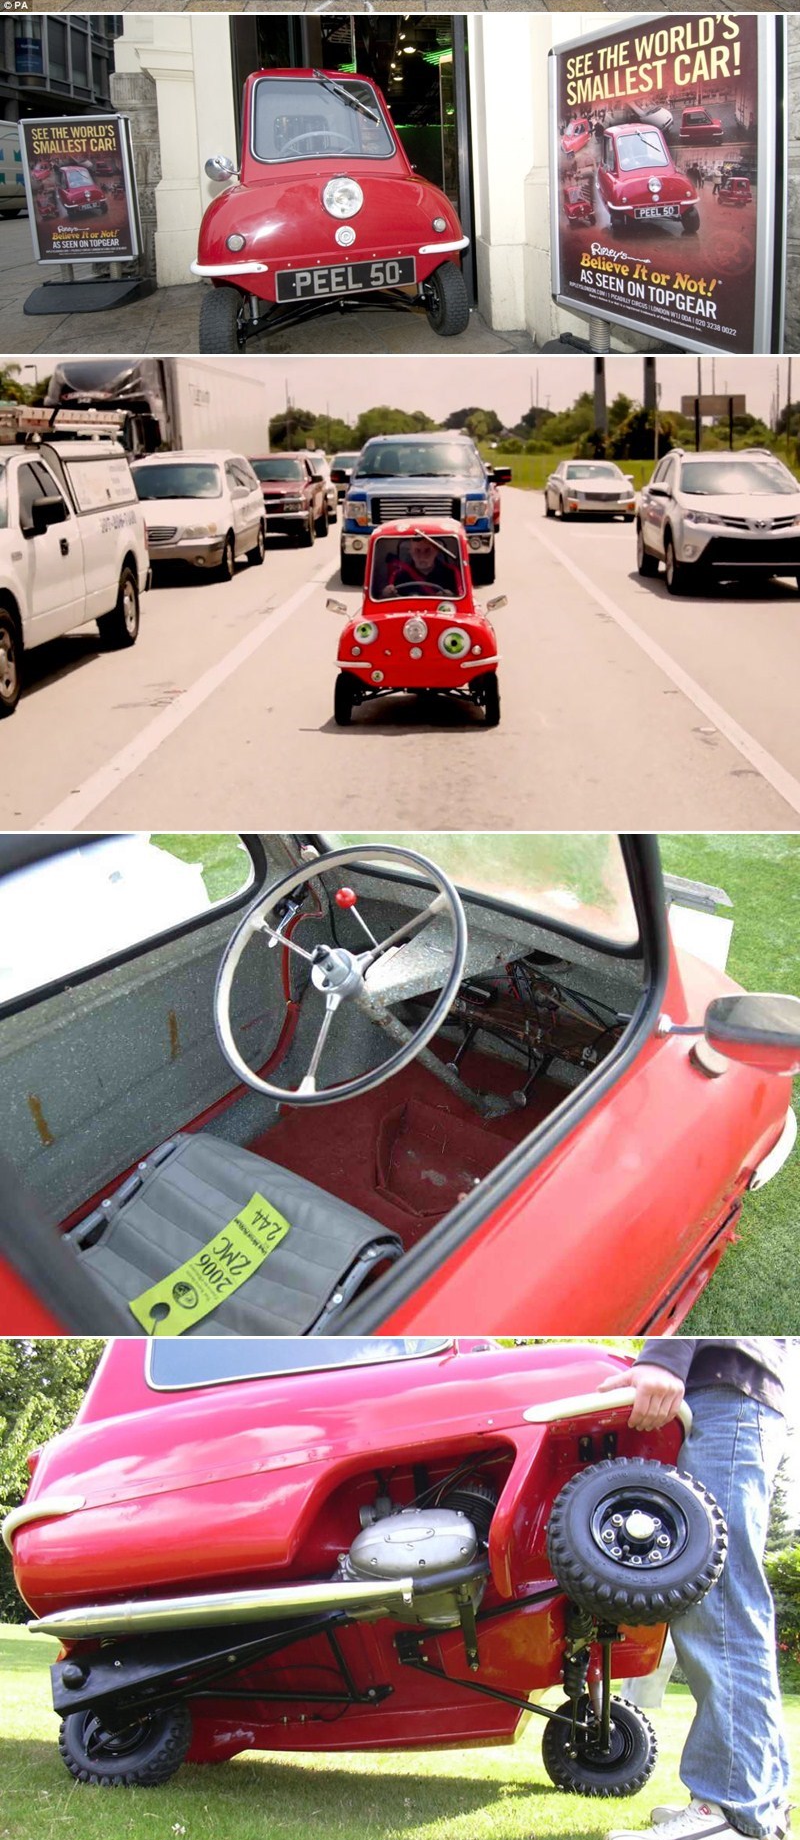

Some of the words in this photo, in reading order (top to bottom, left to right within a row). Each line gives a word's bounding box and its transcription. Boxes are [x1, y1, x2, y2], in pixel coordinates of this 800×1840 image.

[567, 53, 594, 80] SEE
[597, 41, 630, 71] THE
[635, 15, 740, 61] WORLD'S
[567, 59, 667, 106] SMALLEST
[674, 41, 741, 86] CAR!
[31, 128, 50, 140] SEE
[50, 127, 69, 139] THE
[70, 125, 115, 138] WORLD'S
[33, 139, 87, 155] SMALLEST
[90, 138, 117, 152] CAR!
[53, 241, 61, 249] AS
[62, 240, 78, 249] SEEN
[79, 239, 89, 248] ON
[89, 238, 119, 247] TOPGEAR
[295, 266, 363, 297] PEEL
[370, 261, 400, 287] 50
[580, 252, 629, 276] Believe
[633, 263, 648, 281] It
[651, 270, 670, 286] or
[580, 269, 593, 285] AS
[595, 272, 624, 294] SEEN
[627, 280, 645, 299] ON
[648, 285, 717, 319] TOPGEAR
[195, 1253, 233, 1293] 2006
